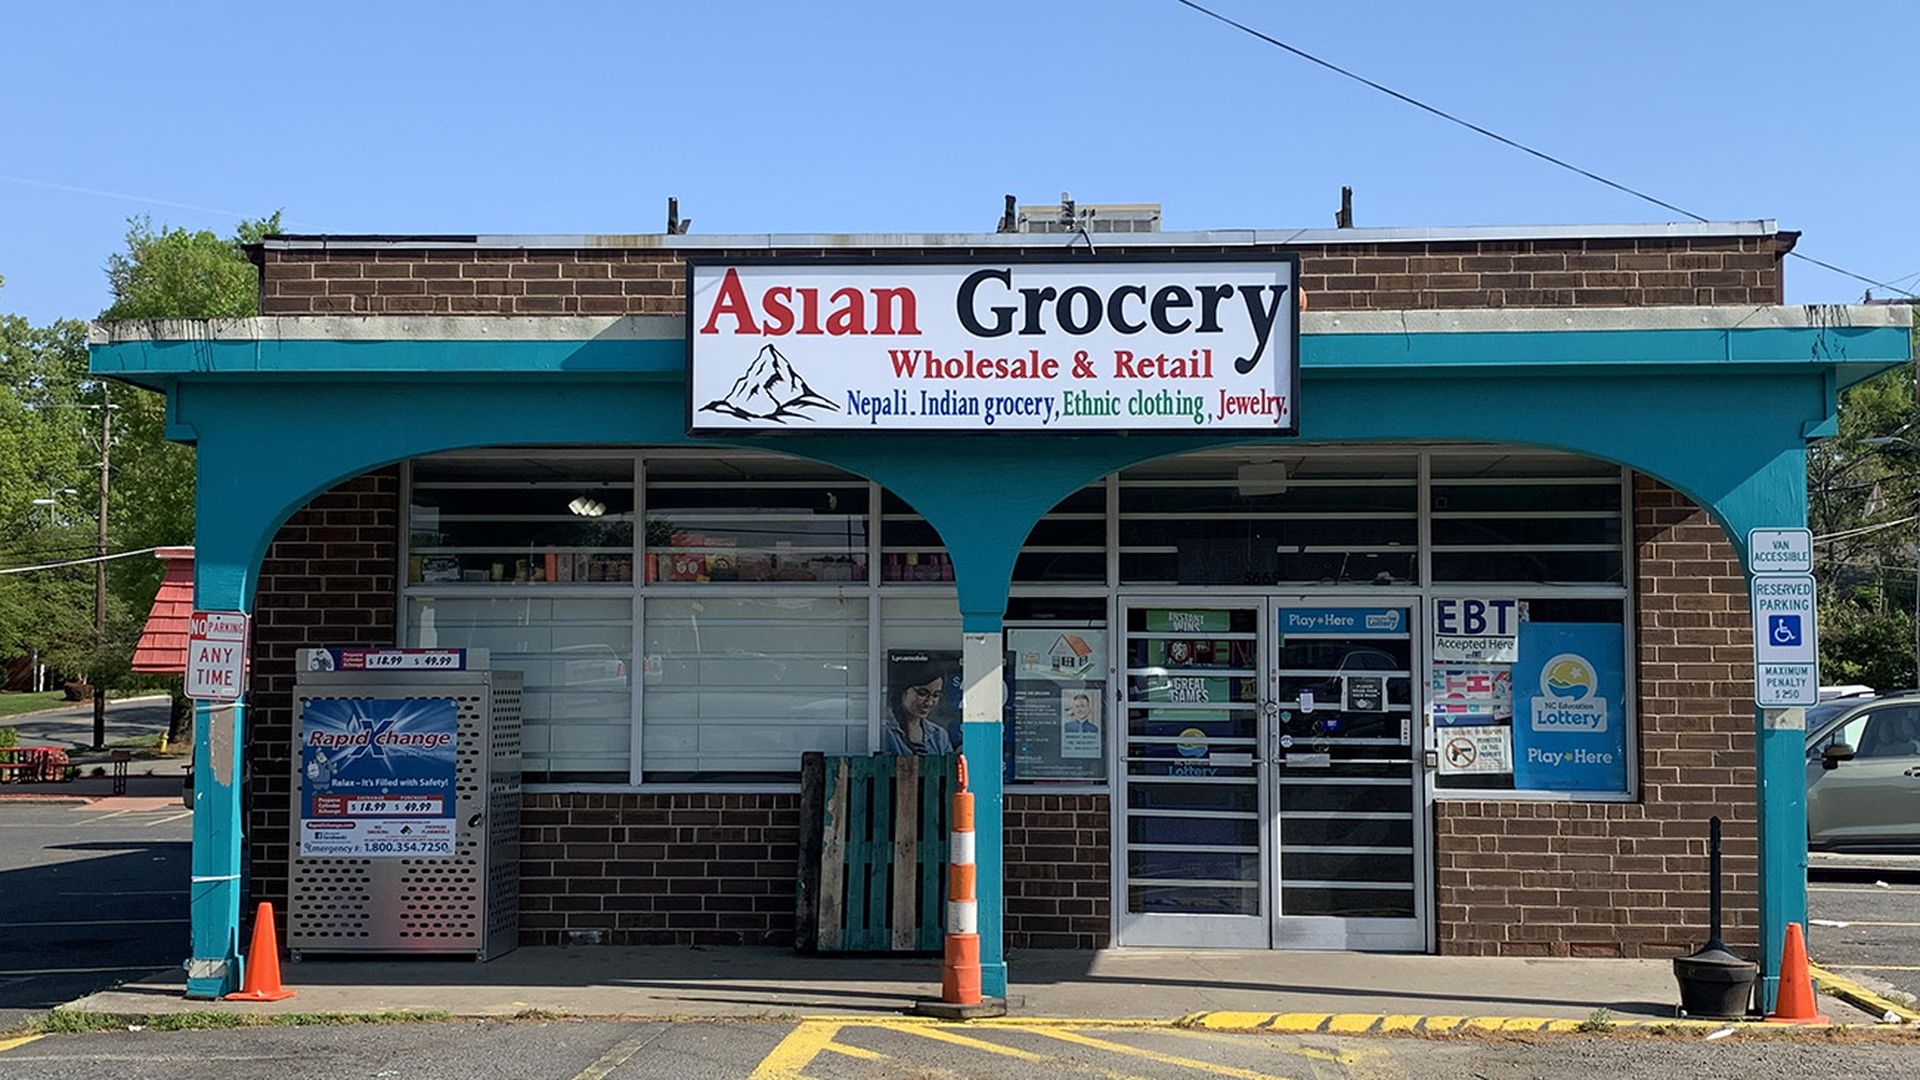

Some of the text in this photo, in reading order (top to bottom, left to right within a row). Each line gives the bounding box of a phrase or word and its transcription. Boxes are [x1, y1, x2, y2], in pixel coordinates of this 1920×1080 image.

[699, 266, 1289, 375] Asian Grocery
[887, 349, 1214, 379] Wholesale & Retail
[919, 389, 980, 417] Indian
[983, 394, 1061, 424] grocery,
[1062, 389, 1121, 417] Ethnic
[1128, 389, 1213, 424] clothing,
[1772, 540, 1790, 550] VAN
[1754, 551, 1809, 562] ACCESSIBLE
[1757, 583, 1811, 596] RESERVED
[1760, 599, 1810, 612] PARKING
[1168, 611, 1204, 625] INSTANT
[1288, 613, 1355, 628] Play Here
[1436, 599, 1516, 635] EBT
[191, 619, 243, 635] NO PARKING
[1173, 621, 1202, 632] WINS
[1436, 638, 1514, 650] Accepted Here
[200, 647, 233, 663] ANY
[376, 656, 403, 666] 18.99
[424, 656, 452, 666] 49.99
[196, 669, 233, 686] TIME
[1765, 666, 1808, 676] MAXIMUM
[1173, 677, 1206, 690] GREAT
[1766, 678, 1807, 687] PENALTY
[1168, 689, 1209, 704] GAMES
[1544, 701, 1594, 710] NC Education
[1537, 710, 1602, 728] Lottery
[1528, 748, 1613, 767] Play Here
[360, 803, 386, 811] 18.99
[405, 803, 432, 811] 49.99
[364, 842, 449, 852] 1.800.354.7250
